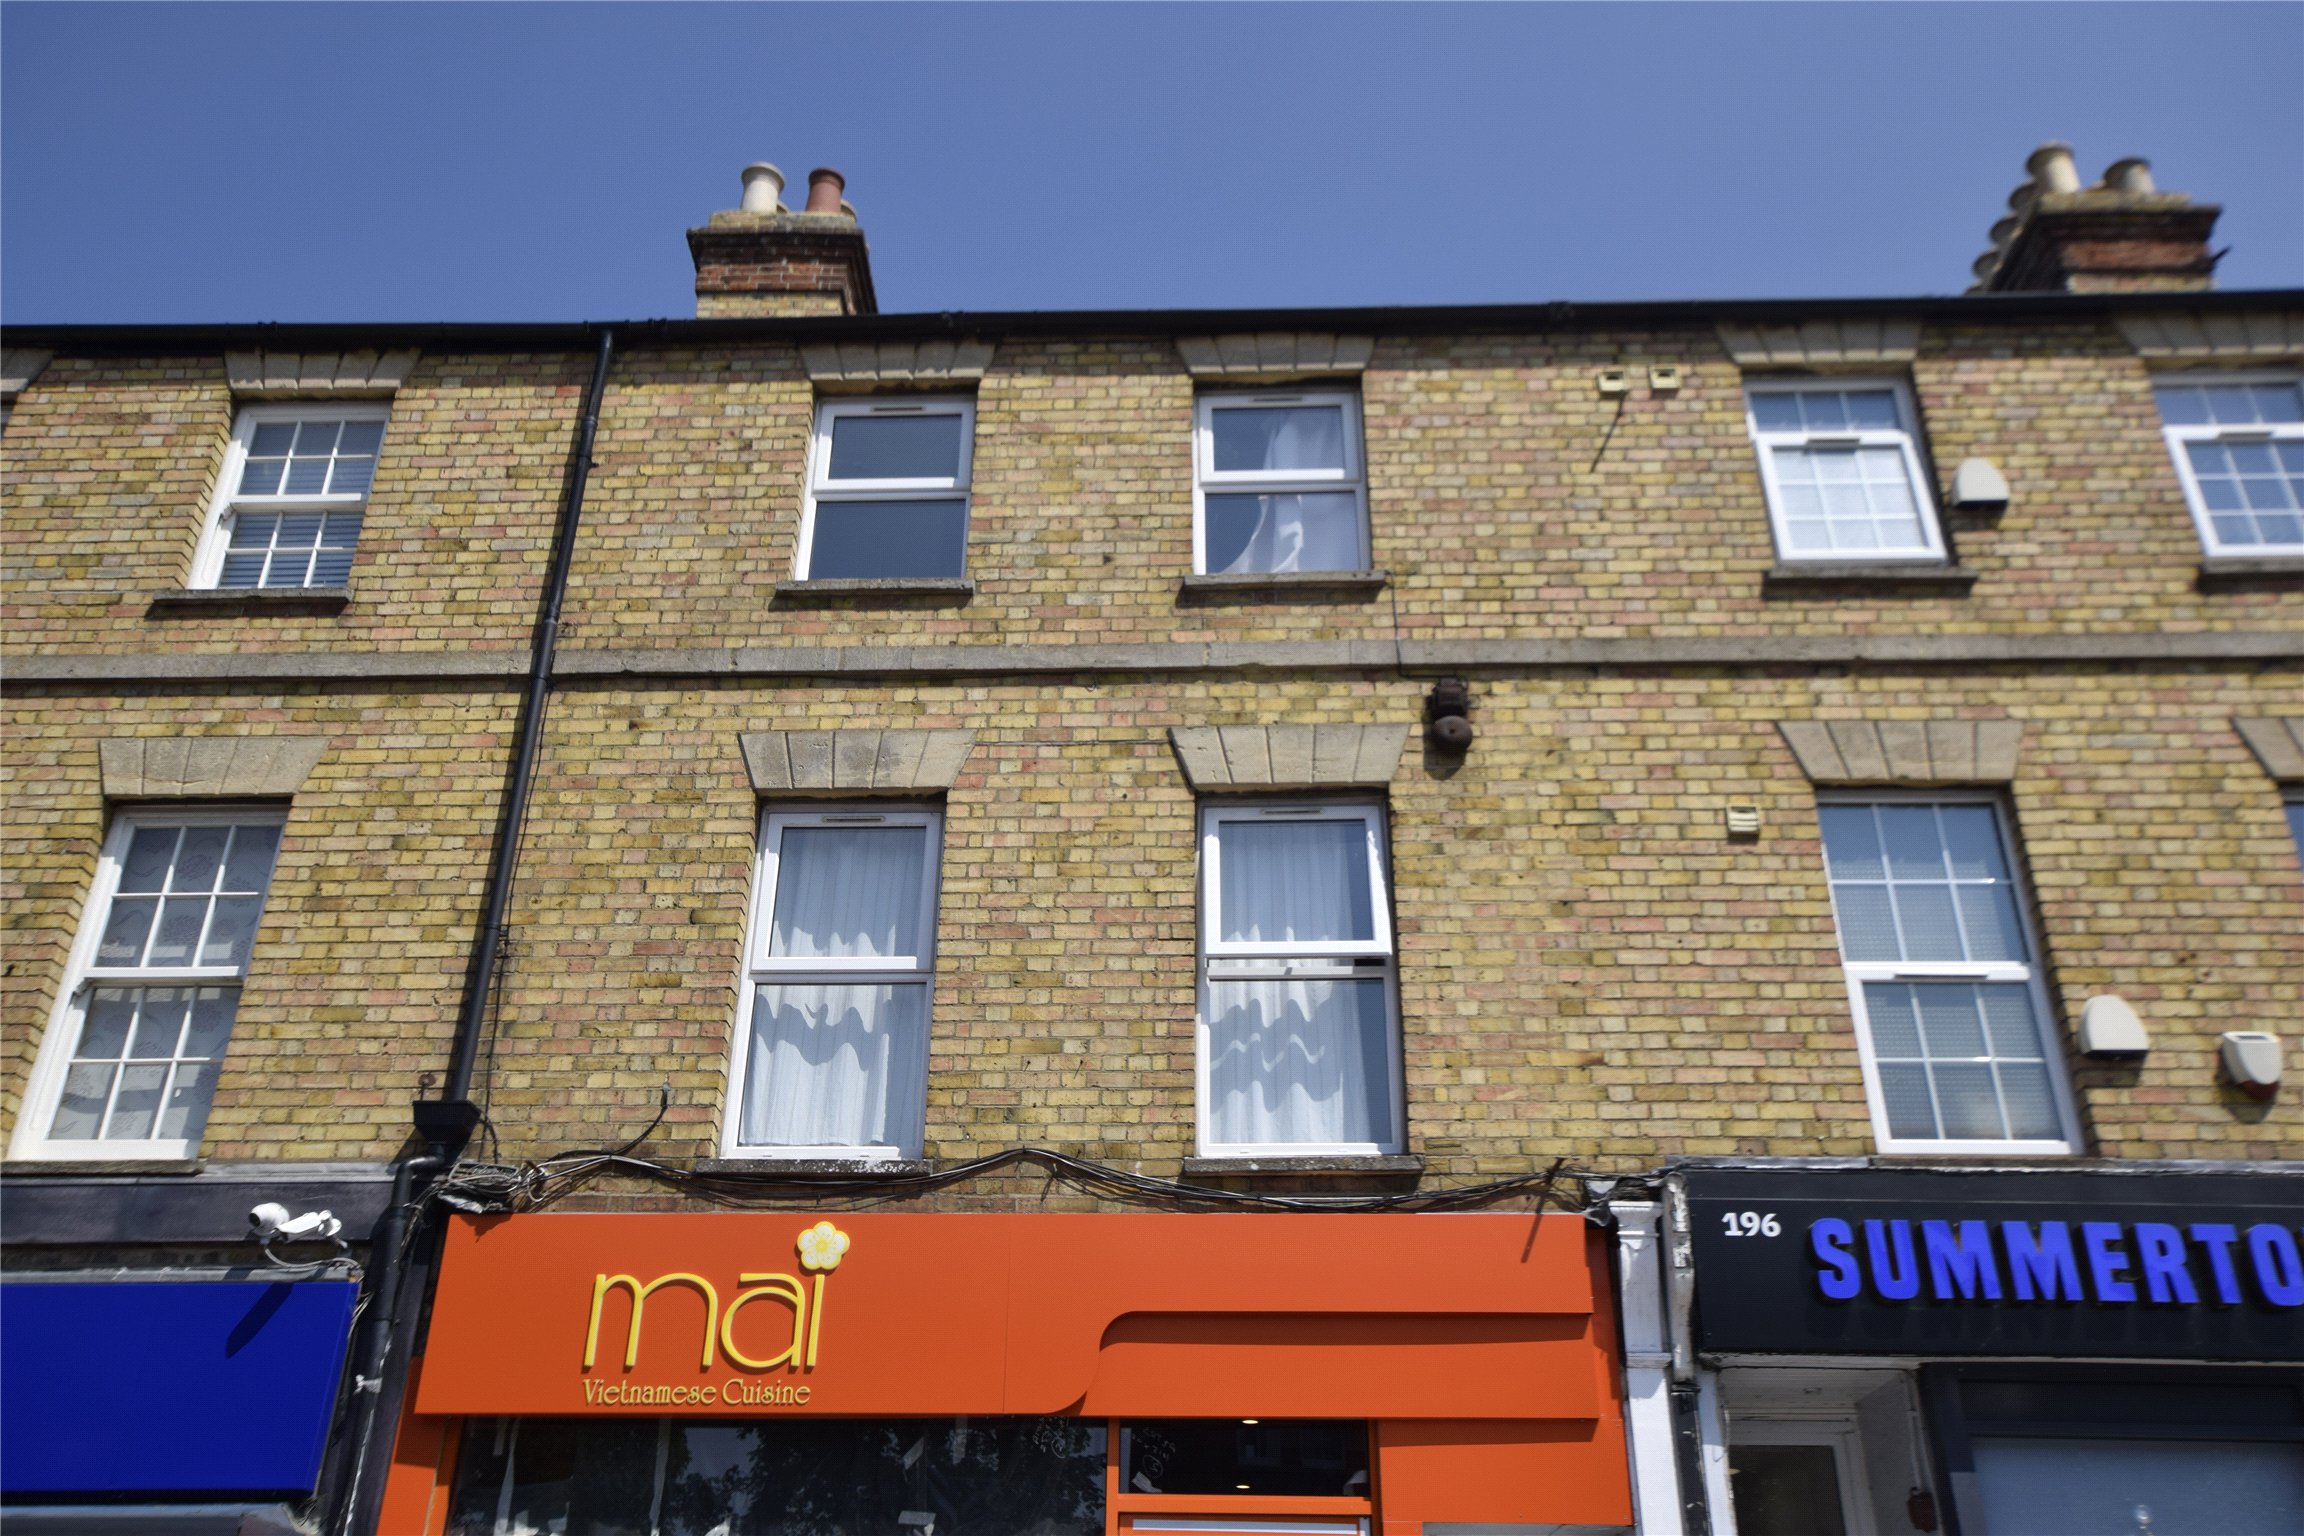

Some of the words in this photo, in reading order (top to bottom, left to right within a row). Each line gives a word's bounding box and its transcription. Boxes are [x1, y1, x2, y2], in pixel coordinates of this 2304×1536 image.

[1721, 1211, 1782, 1238] 196
[1810, 1217, 2304, 1307] SUMMERTO
[584, 1272, 826, 1368] mai
[583, 1378, 717, 1405] Vietnamese
[721, 1378, 812, 1405] Cuisine
